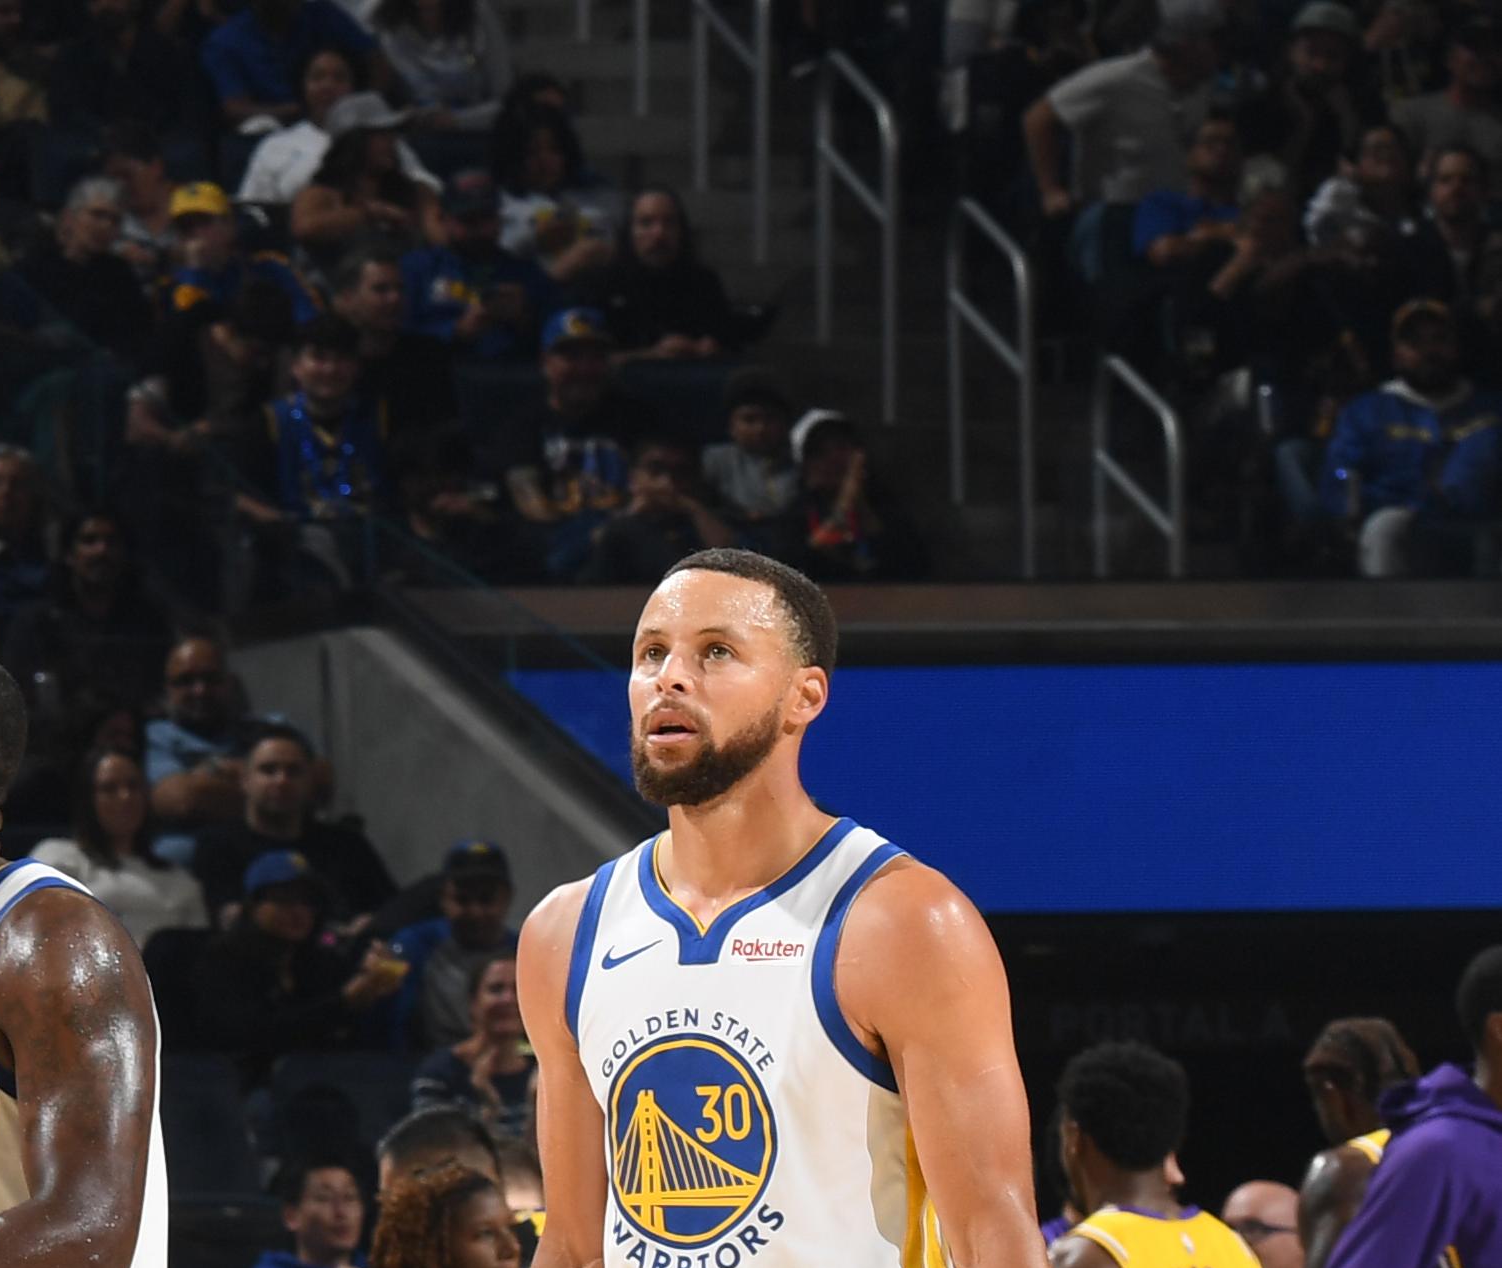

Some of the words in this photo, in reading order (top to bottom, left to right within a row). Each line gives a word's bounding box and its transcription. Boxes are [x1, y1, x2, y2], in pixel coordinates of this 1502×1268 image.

[731, 938, 805, 961] Rakuten
[602, 1008, 700, 1079] GOLDEN
[711, 1012, 775, 1072] STATE
[694, 1083, 752, 1143] 30
